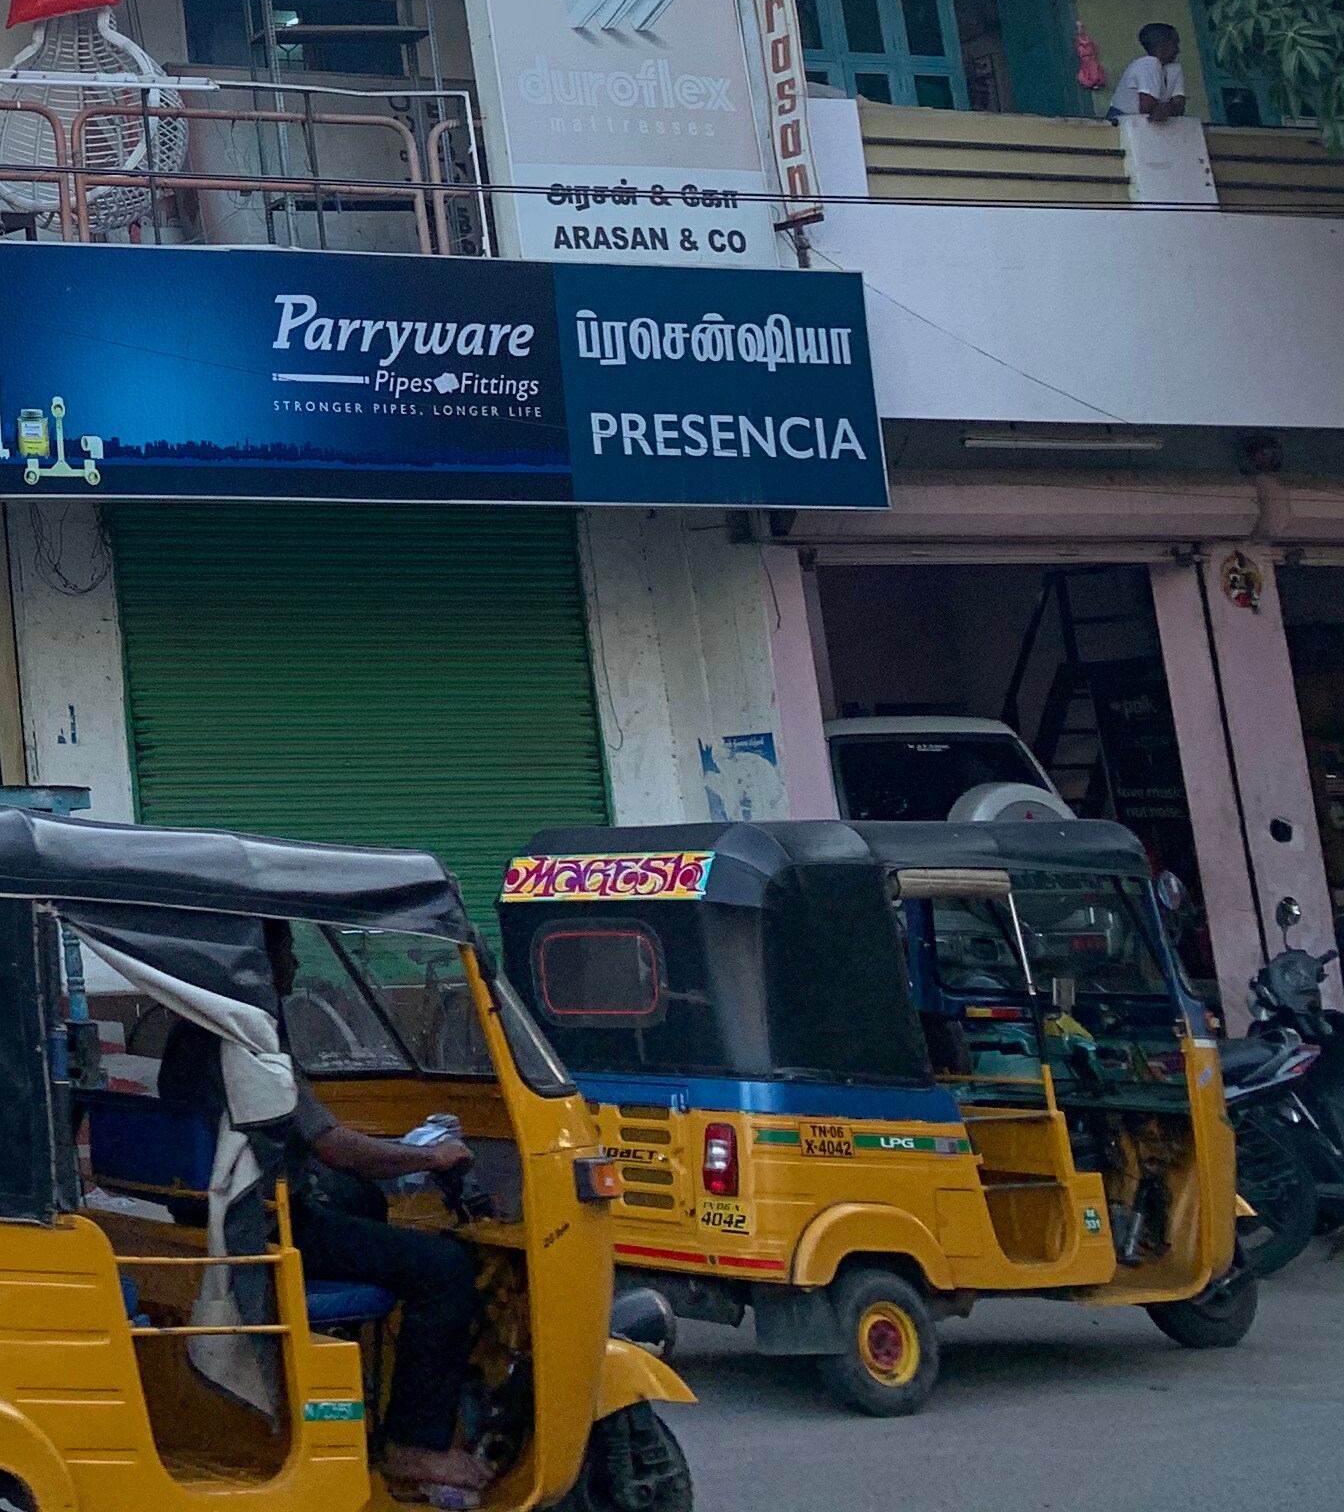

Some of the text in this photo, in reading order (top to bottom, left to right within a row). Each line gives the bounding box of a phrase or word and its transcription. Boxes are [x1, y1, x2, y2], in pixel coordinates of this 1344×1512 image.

[519, 56, 736, 114] duroflex
[550, 116, 716, 137] mattresses
[554, 225, 747, 254] ARASAN & CO
[271, 293, 536, 367] Parryware
[373, 369, 540, 402] Pipes Fittings
[272, 400, 364, 414] STRONGER
[432, 404, 500, 418] LONGER
[508, 405, 543, 419] LIFE
[589, 411, 868, 461] PRESENCIA
[879, 1137, 915, 1150] LPG
[700, 1211, 747, 1229] 4042
